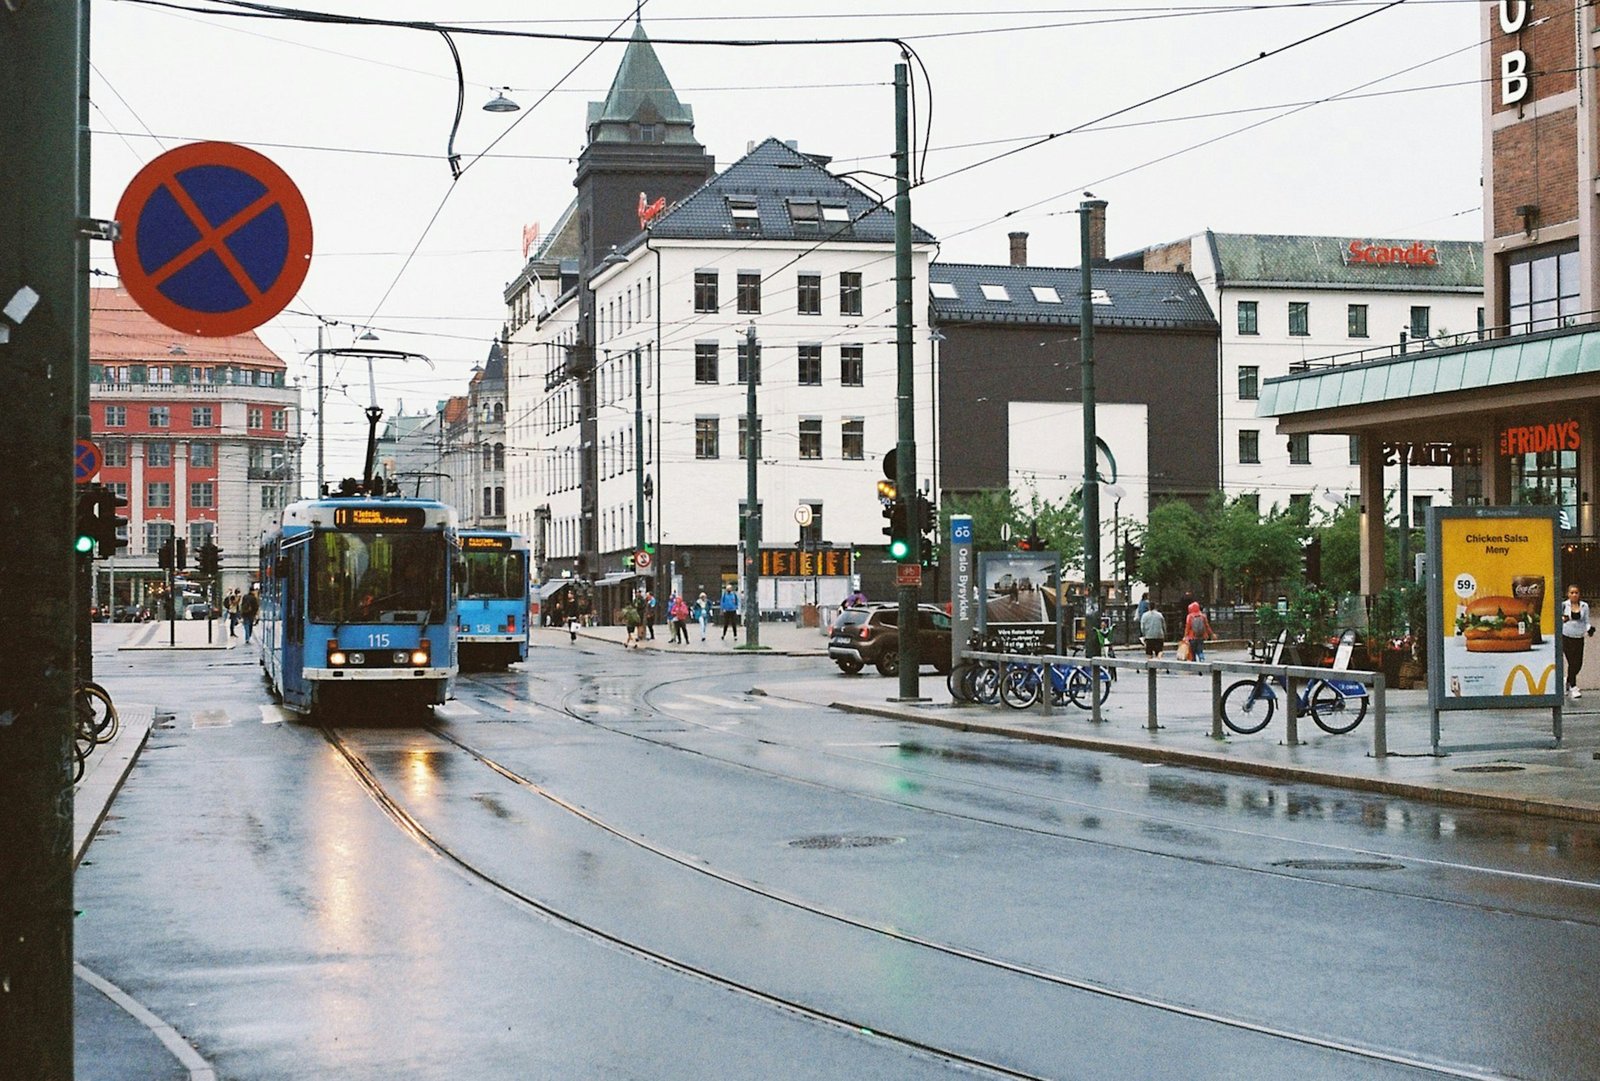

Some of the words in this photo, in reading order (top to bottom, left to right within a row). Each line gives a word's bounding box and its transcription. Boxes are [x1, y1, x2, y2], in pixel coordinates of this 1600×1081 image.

[1349, 240, 1437, 265] Scandic
[336, 509, 347, 524] 11
[1465, 534, 1503, 543] Chicken
[1503, 534, 1529, 543] Salsa
[1485, 546, 1510, 556] Meny
[959, 548, 968, 572] Oslo
[957, 574, 969, 621] Bysykkel
[476, 624, 491, 633] 128
[368, 634, 391, 648] 115
